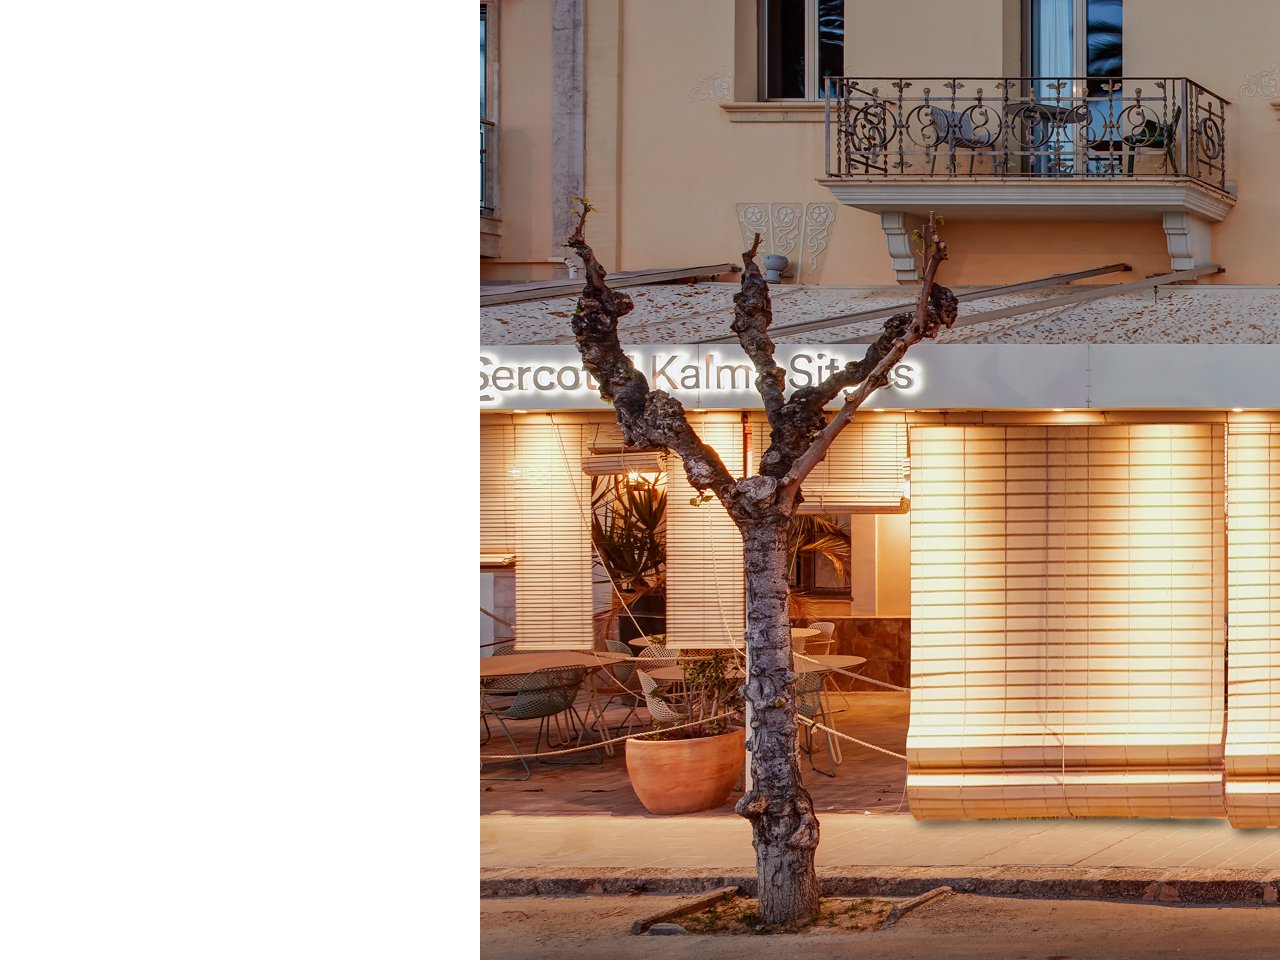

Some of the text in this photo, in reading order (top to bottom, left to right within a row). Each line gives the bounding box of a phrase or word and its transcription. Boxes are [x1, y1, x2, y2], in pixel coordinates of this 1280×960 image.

[480, 352, 914, 402] Sercot Kalm Sits
